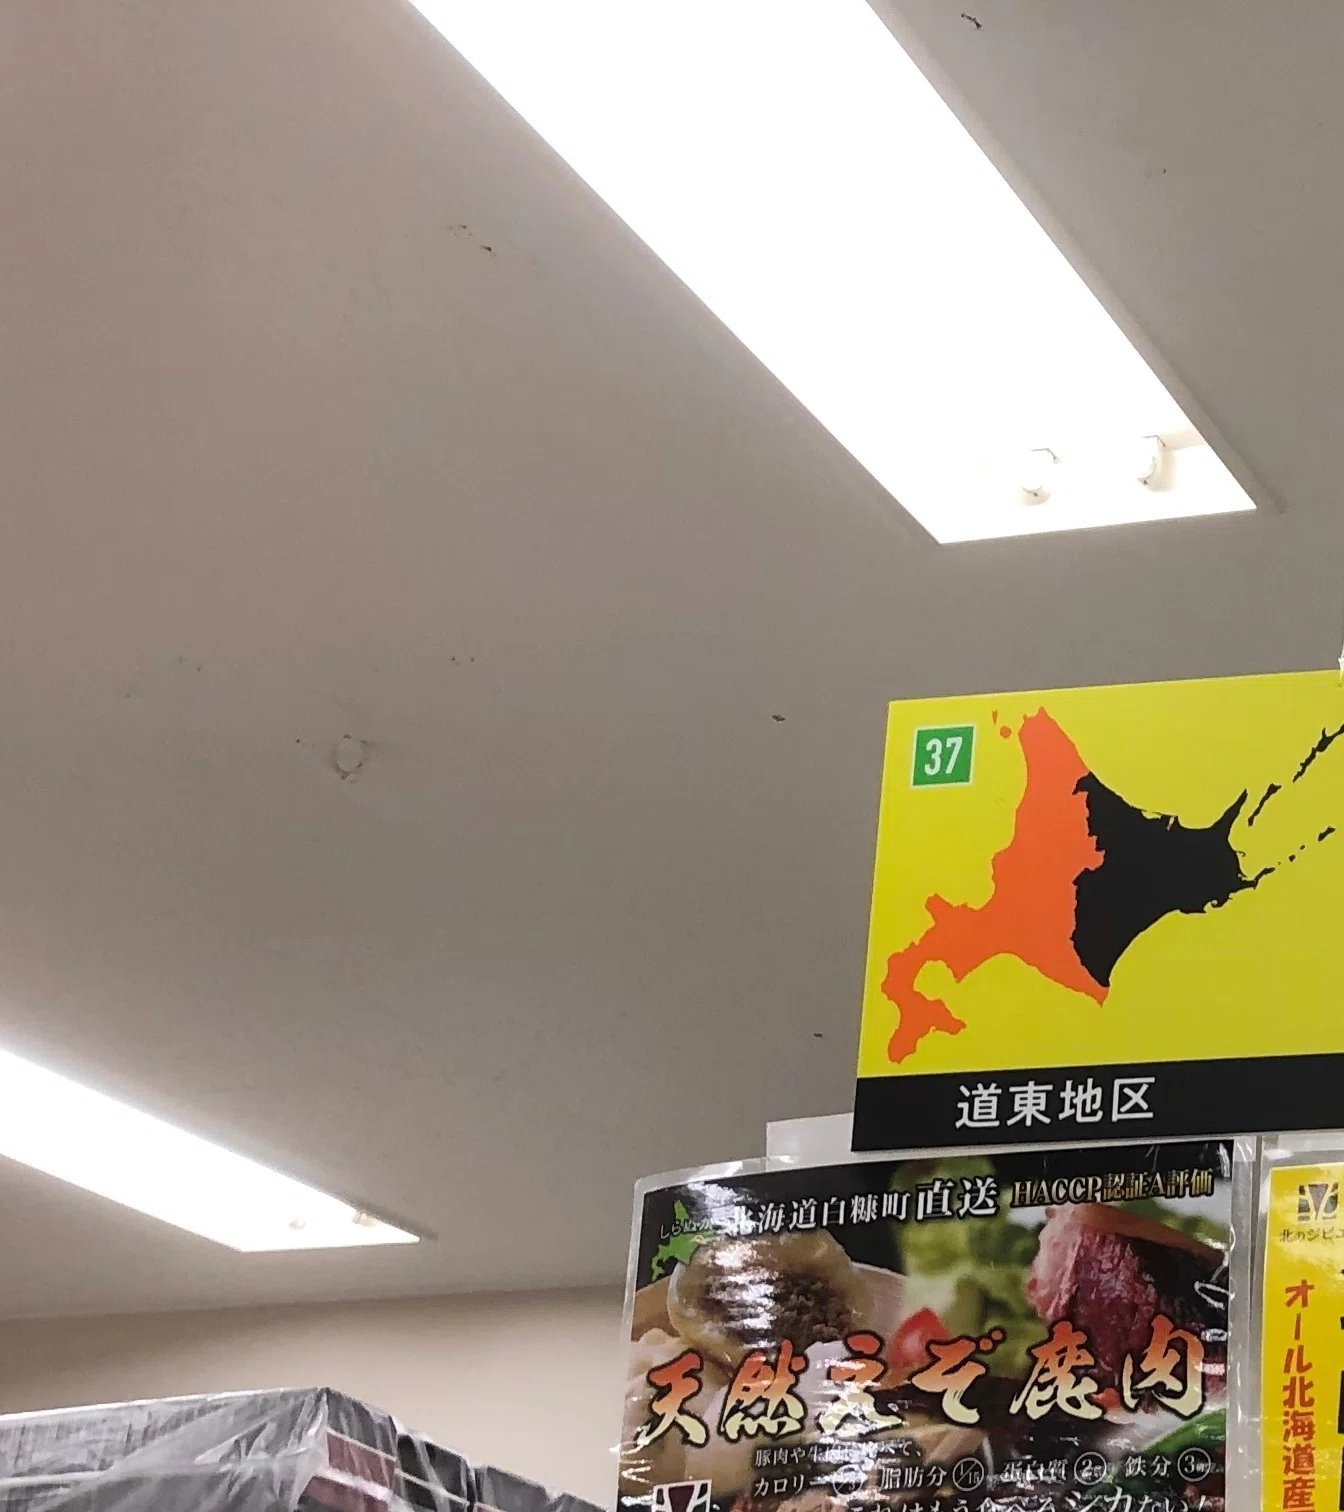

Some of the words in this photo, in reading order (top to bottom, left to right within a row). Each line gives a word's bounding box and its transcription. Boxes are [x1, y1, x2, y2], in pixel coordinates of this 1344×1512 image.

[924, 737, 963, 777] 37
[954, 1076, 1156, 1129] 道東地区
[1011, 1167, 1215, 1209] HACCP認証A評価
[634, 1315, 1209, 1448] 天然えぞ鹿肉
[753, 1472, 827, 1498] カロリー
[880, 1461, 948, 1491] 脂肪分
[1124, 1454, 1172, 1478] 鉄分
